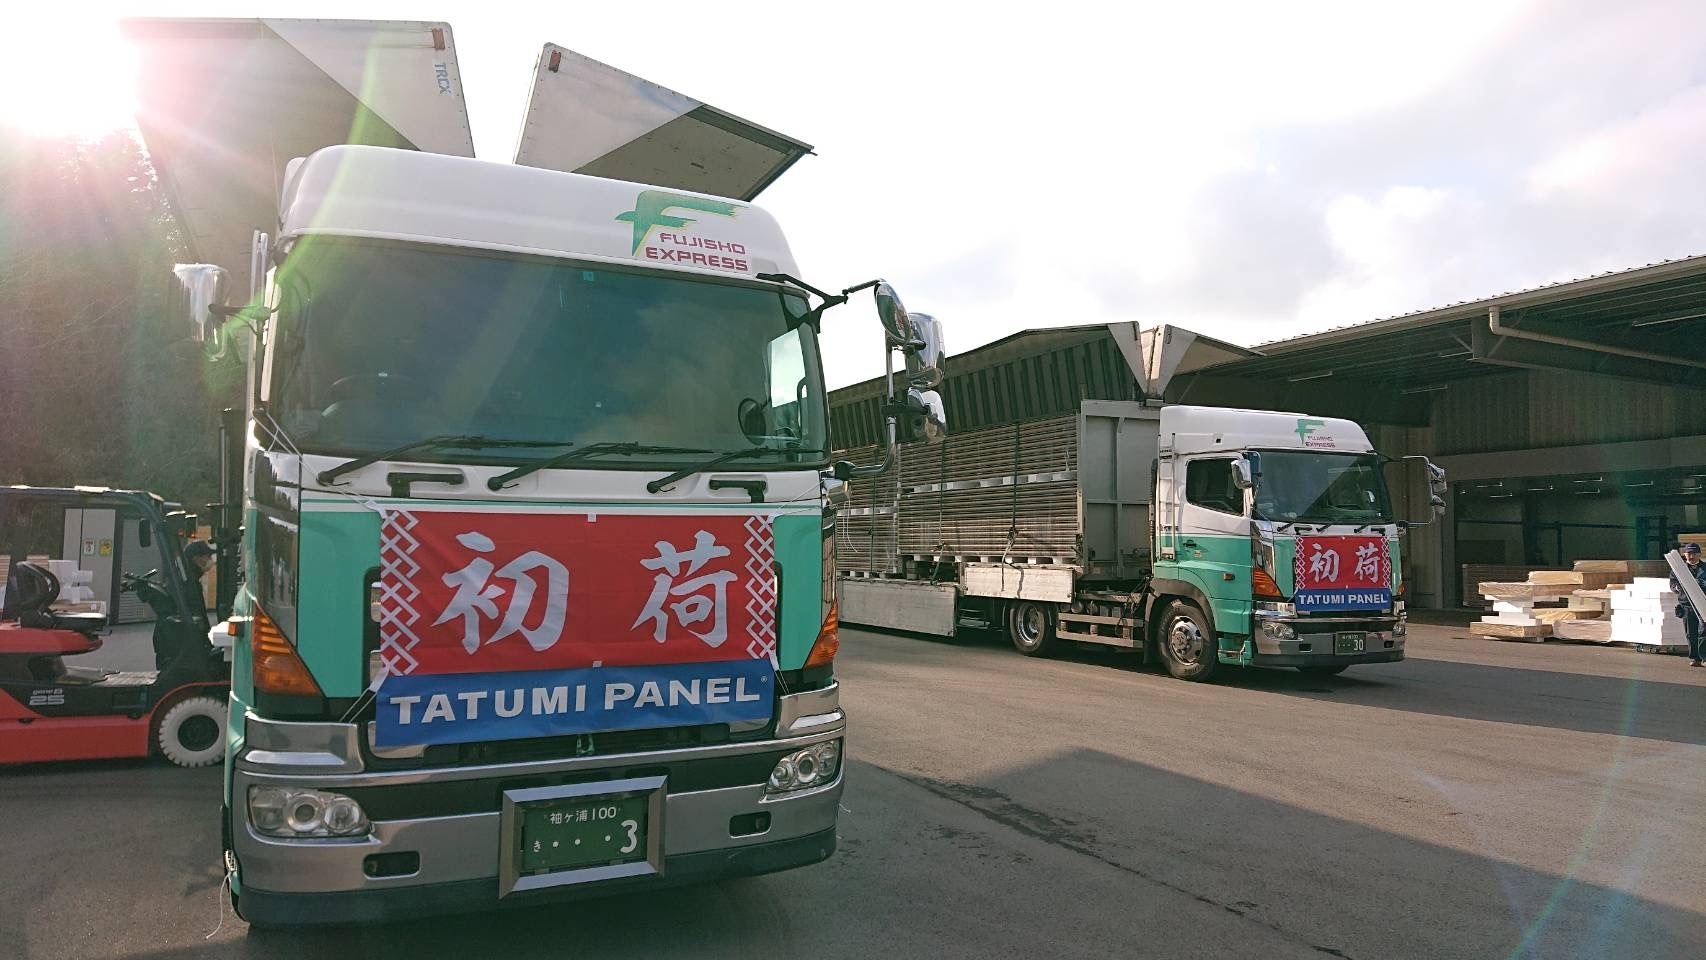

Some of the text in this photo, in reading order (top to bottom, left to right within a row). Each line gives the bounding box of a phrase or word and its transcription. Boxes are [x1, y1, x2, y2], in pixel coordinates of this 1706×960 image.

[660, 233, 745, 254] FUJISHO
[646, 247, 748, 271] EXPRESS
[431, 530, 738, 655] 初荷
[1299, 593, 1387, 605] TATUMI PANEL
[390, 677, 760, 725] TATUMI PANEL
